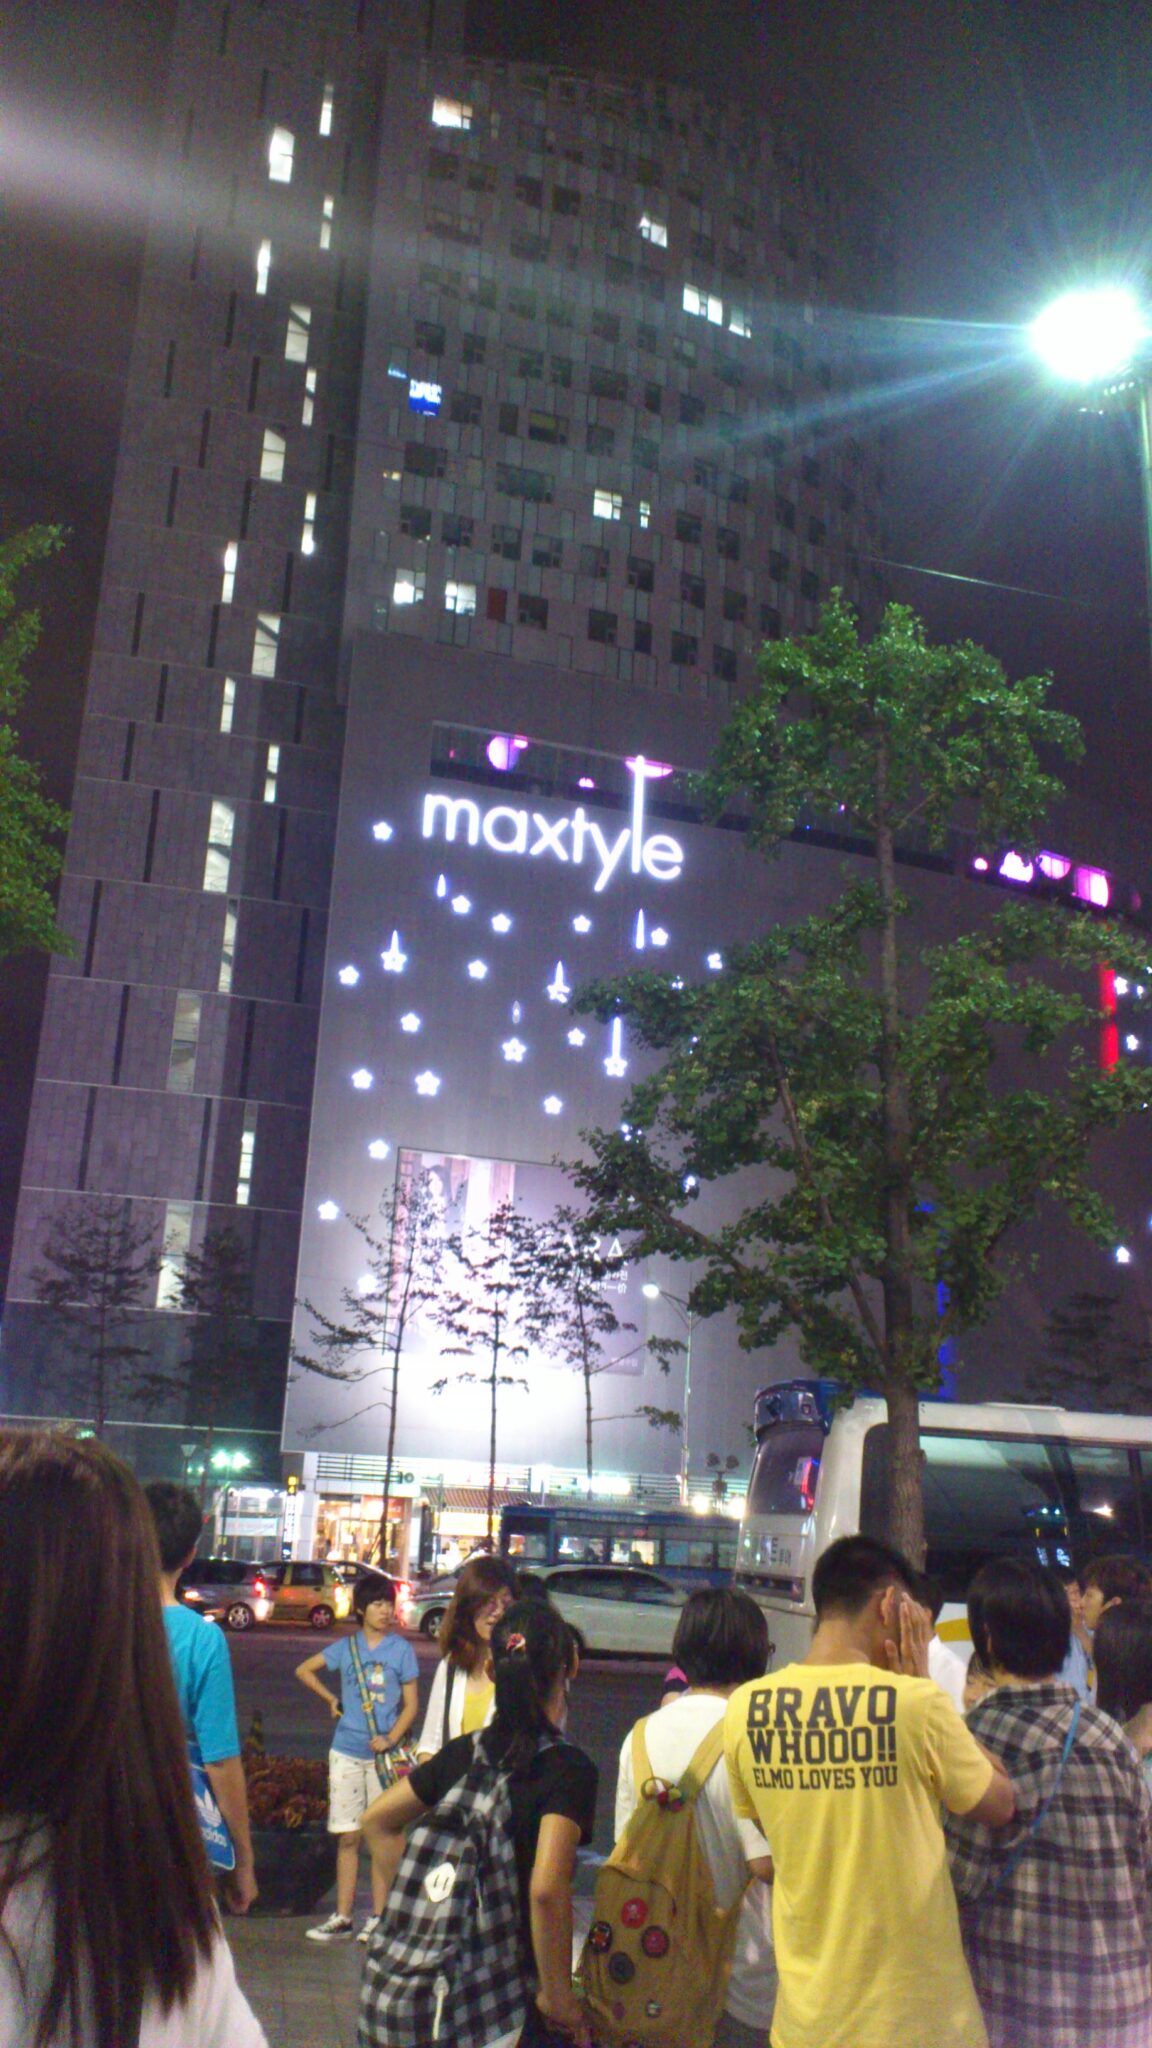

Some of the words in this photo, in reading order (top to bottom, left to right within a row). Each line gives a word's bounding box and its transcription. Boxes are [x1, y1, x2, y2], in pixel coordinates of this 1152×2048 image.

[422, 755, 684, 892] maxtyle
[747, 1685, 897, 1728] BRAVO
[747, 1725, 897, 1764] WHOOO!!
[752, 1768, 794, 1788] ELMO
[798, 1767, 855, 1790] LOVES
[860, 1765, 898, 1787] YOU
